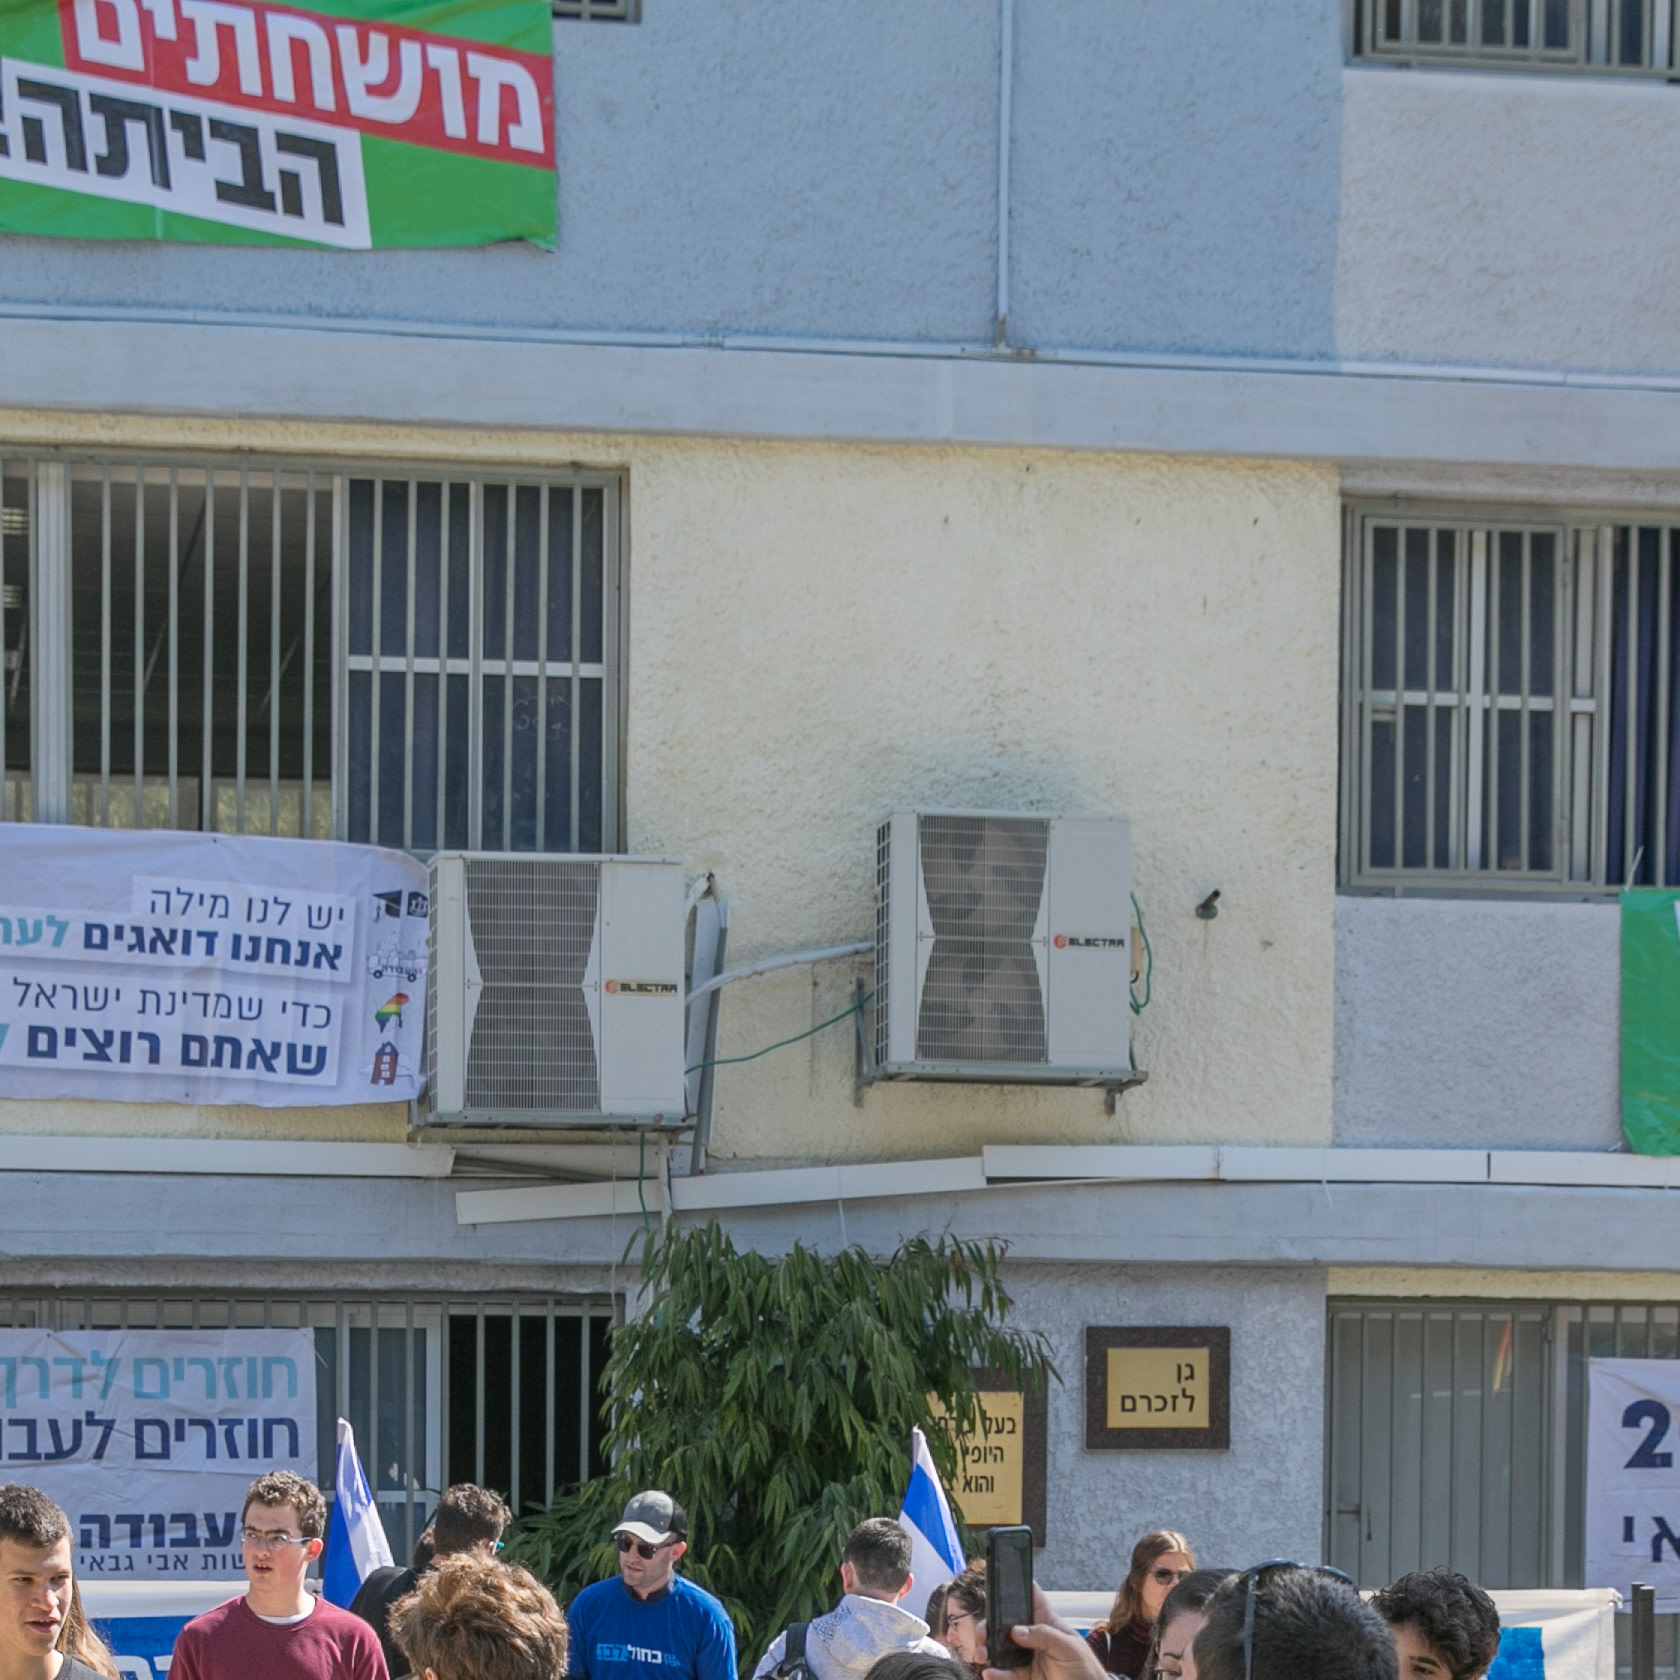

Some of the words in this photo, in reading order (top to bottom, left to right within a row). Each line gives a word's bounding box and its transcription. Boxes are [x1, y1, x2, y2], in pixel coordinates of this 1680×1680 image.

[77, 0, 545, 154] מושחתים
[150, 886, 230, 919] מילה
[246, 896, 292, 927] לנו
[307, 904, 345, 931] יש
[83, 922, 218, 957] דואגים
[230, 933, 343, 972] אנחנו
[13, 976, 121, 1012] ישראל
[137, 988, 263, 1021] שמדינת
[620, 983, 678, 993] ELECTRA
[281, 1001, 332, 1030] כדי
[26, 1024, 161, 1066] רוצים
[180, 1032, 328, 1077] שאתם
[133, 1356, 299, 1401] חוזרים
[1175, 1363, 1196, 1385] גן
[1120, 1388, 1196, 1414] לזכרם
[134, 1417, 300, 1460] חוזרים
[79, 1511, 237, 1549] עבודה
[79, 1553, 135, 1573] גבאי
[148, 1553, 188, 1571] אבי
